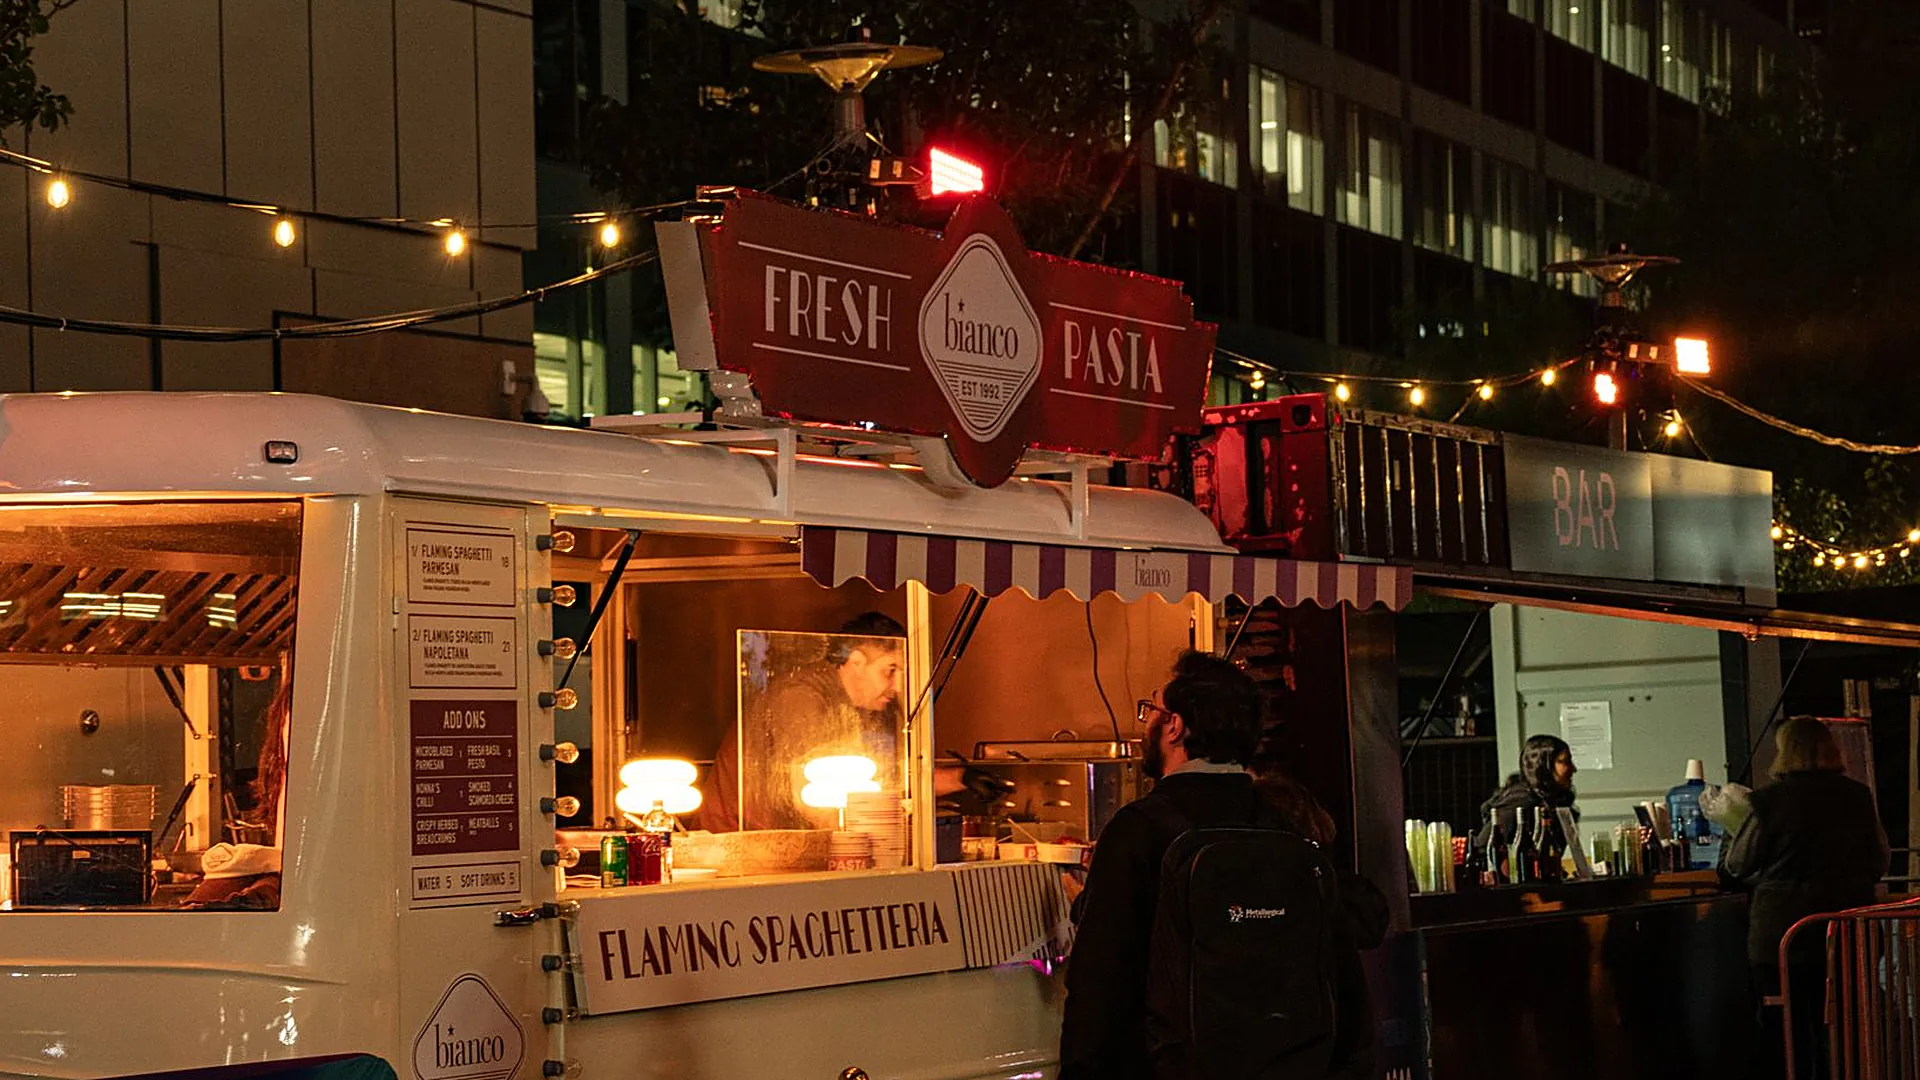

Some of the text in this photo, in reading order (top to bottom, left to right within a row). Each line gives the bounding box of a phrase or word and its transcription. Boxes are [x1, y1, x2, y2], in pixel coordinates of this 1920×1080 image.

[765, 265, 891, 351] FRESH
[944, 293, 1018, 359] bianco
[1064, 320, 1163, 393] PASTA
[961, 380, 1000, 400] EST 1992
[1552, 466, 1619, 550] BAR
[421, 544, 453, 559] FLAMING
[454, 546, 493, 561] SPAGHETTI
[422, 561, 460, 575] PARMESAN
[501, 556, 509, 568] 18
[1134, 554, 1171, 587] bianco
[423, 629, 455, 643] FLAMING
[455, 630, 493, 645] SPAGHETTI
[424, 646, 469, 660] NAPOLETANA
[443, 710, 486, 729] ADD ONS
[467, 744, 501, 756] FRESH BASIL
[467, 758, 486, 769] PESTO
[468, 781, 491, 793] SMOKED
[495, 793, 515, 805] CHEESE
[416, 818, 459, 831] CRISPY HERBED
[468, 817, 500, 829] MEATBALLS
[416, 832, 457, 845] BREADCRUMBS
[418, 872, 515, 891] WATER 5 SOFT DRINKS 5
[599, 901, 949, 981] FLAMING SPAGHETTERIA
[434, 1023, 504, 1069] bianco
